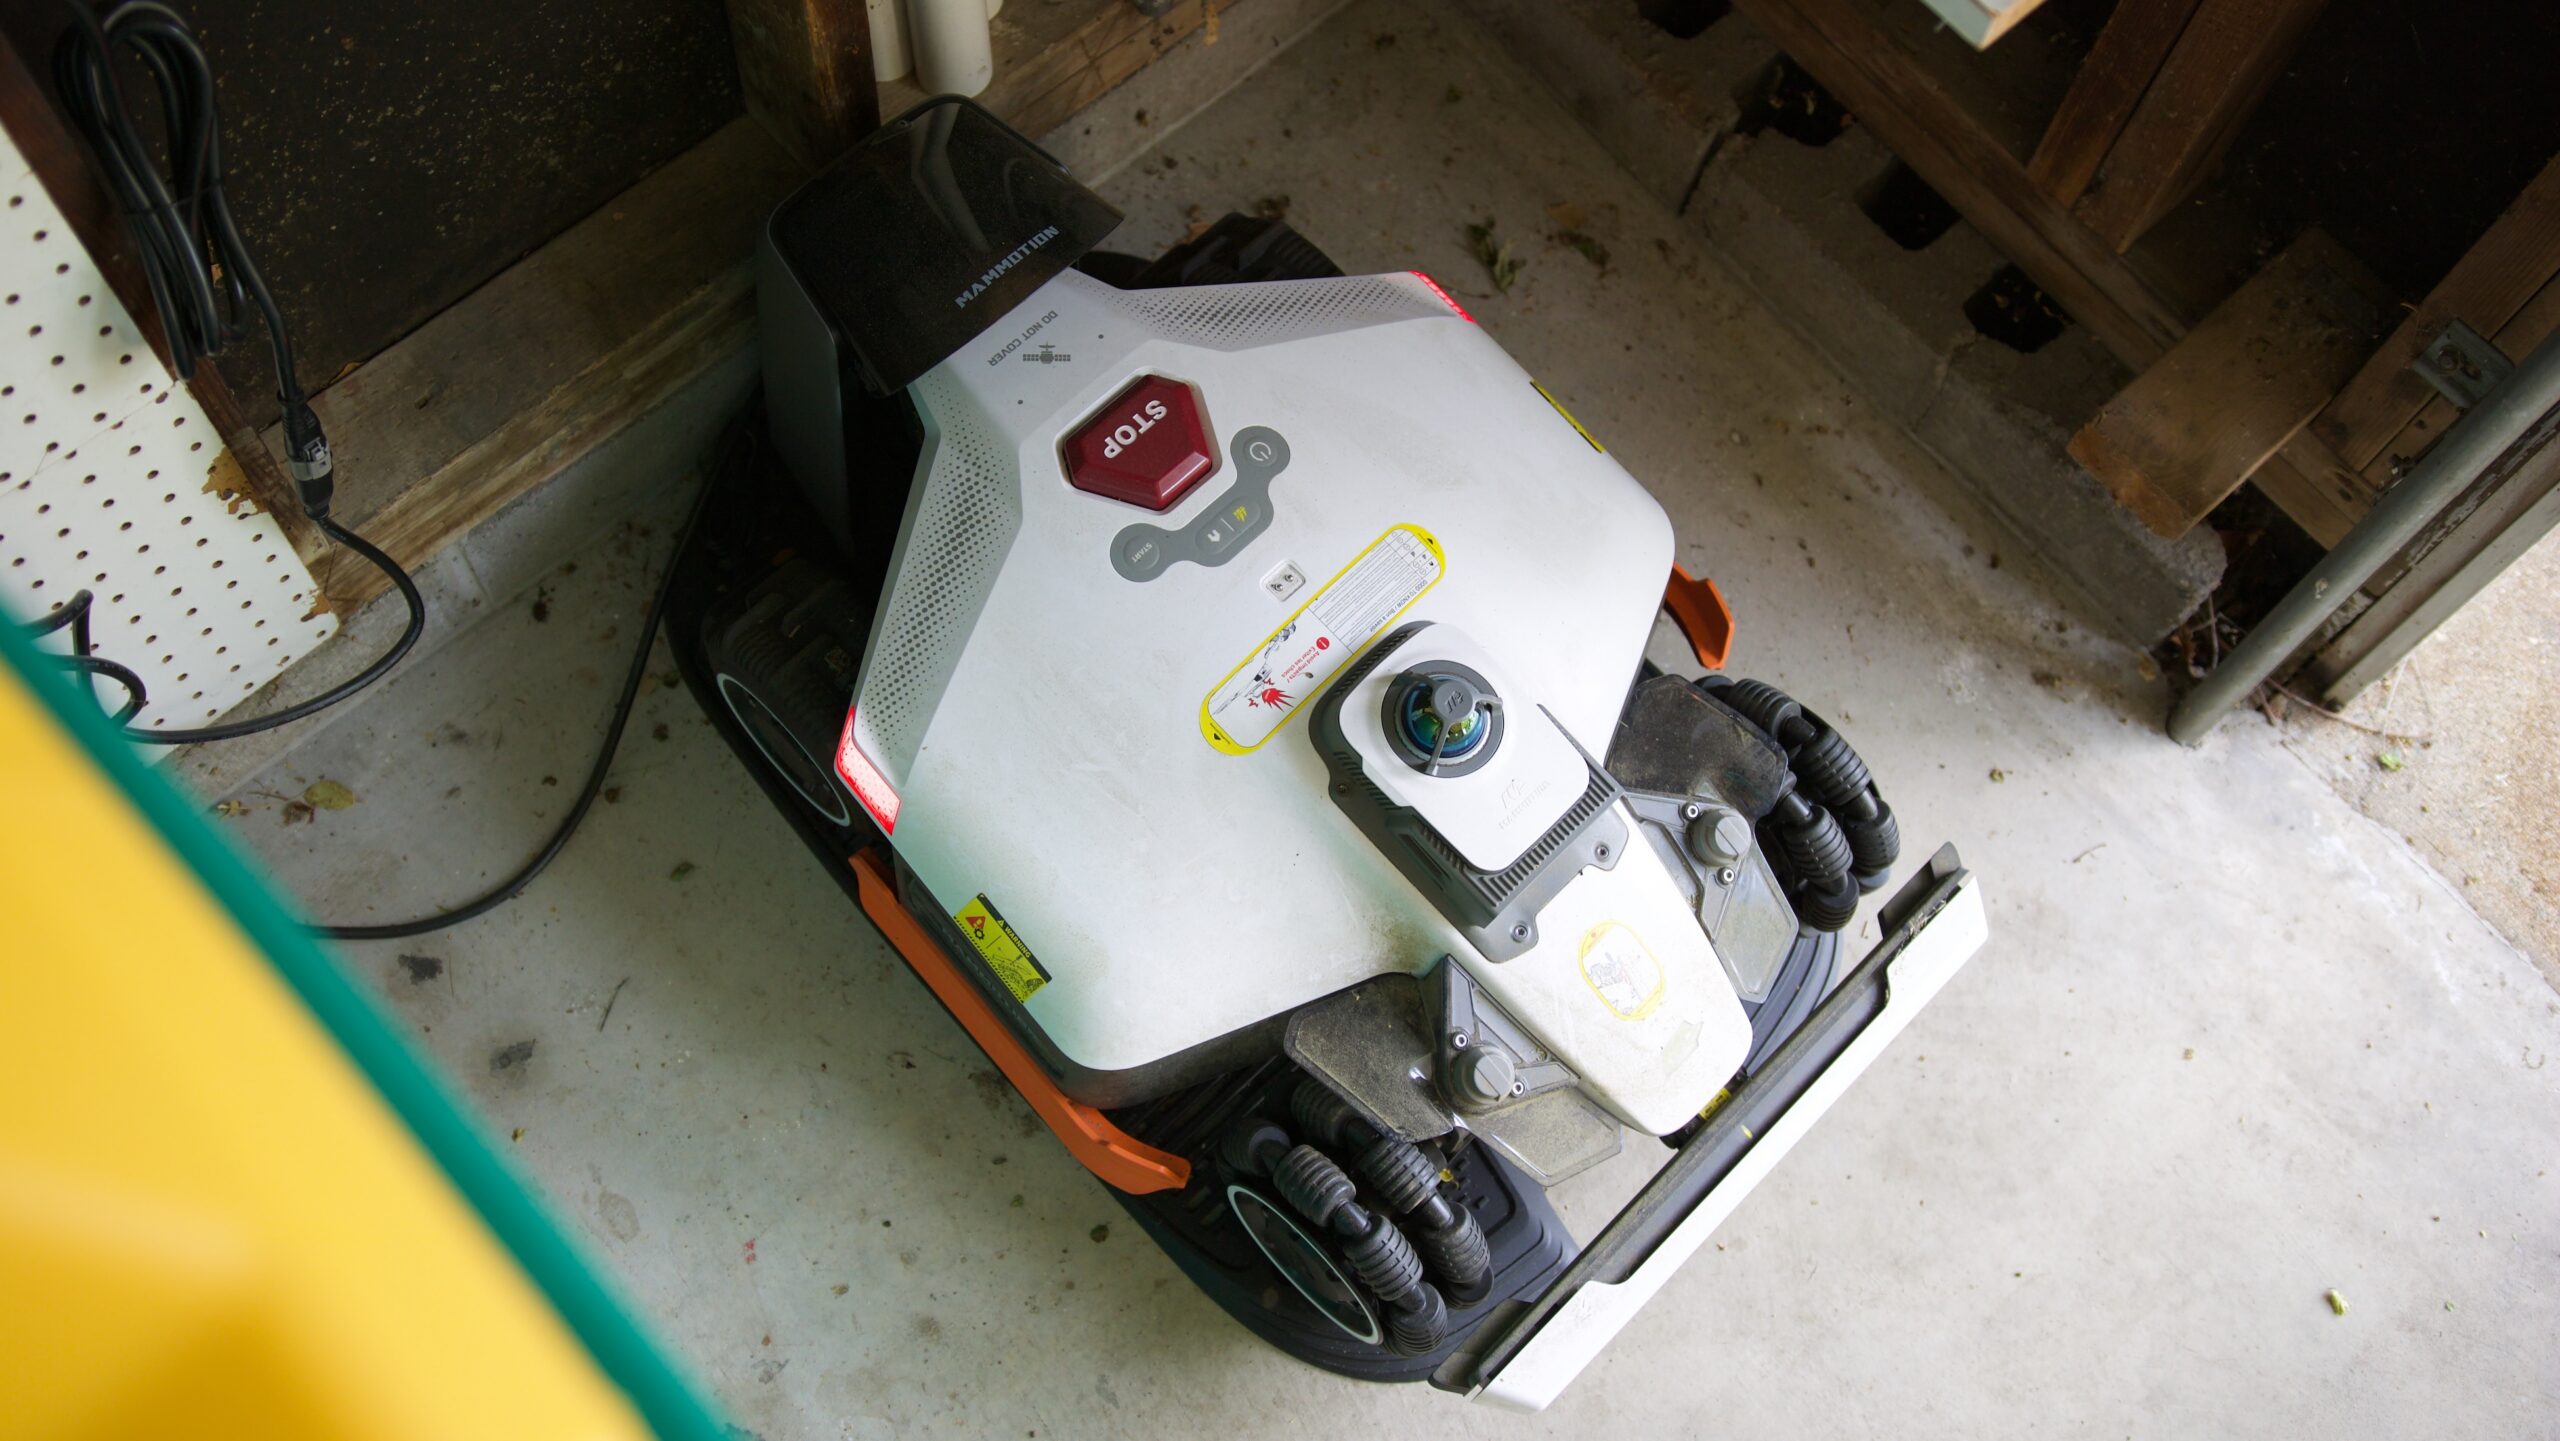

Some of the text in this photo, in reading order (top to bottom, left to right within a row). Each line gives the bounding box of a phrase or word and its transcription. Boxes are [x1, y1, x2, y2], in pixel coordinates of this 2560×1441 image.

[954, 225, 1060, 309] MAMMOTION
[988, 310, 1058, 367] DO NOT COVER
[1104, 400, 1167, 458] STOP
[1131, 542, 1152, 563] START
[1306, 650, 1320, 664] Avoid
[1005, 927, 1031, 958] WARNING
